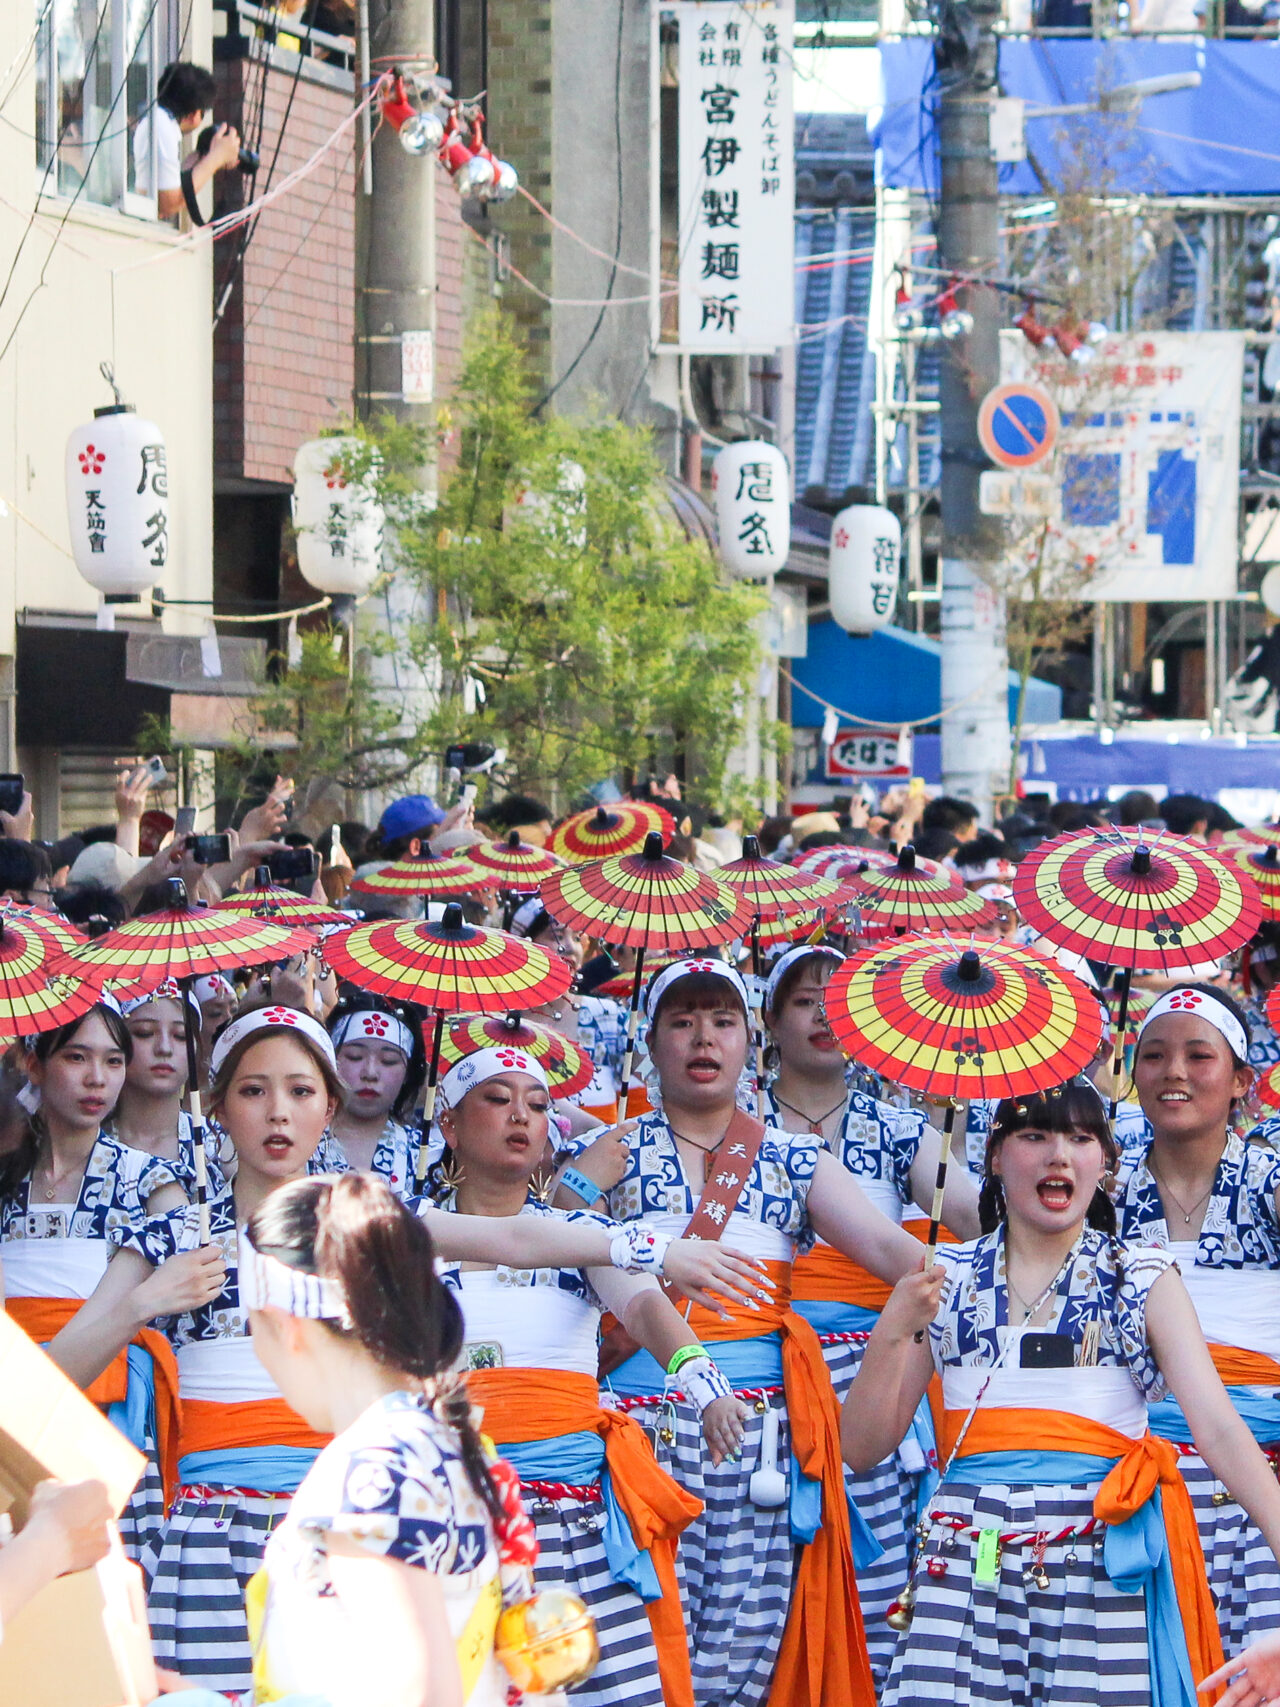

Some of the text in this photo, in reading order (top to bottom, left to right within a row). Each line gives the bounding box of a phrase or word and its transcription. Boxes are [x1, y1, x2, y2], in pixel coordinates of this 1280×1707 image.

[699, 21, 717, 66] 会社
[723, 22, 741, 66] 有限
[762, 23, 780, 196] 各種うどんそば卸
[700, 83, 741, 334] 宮伊製麺所
